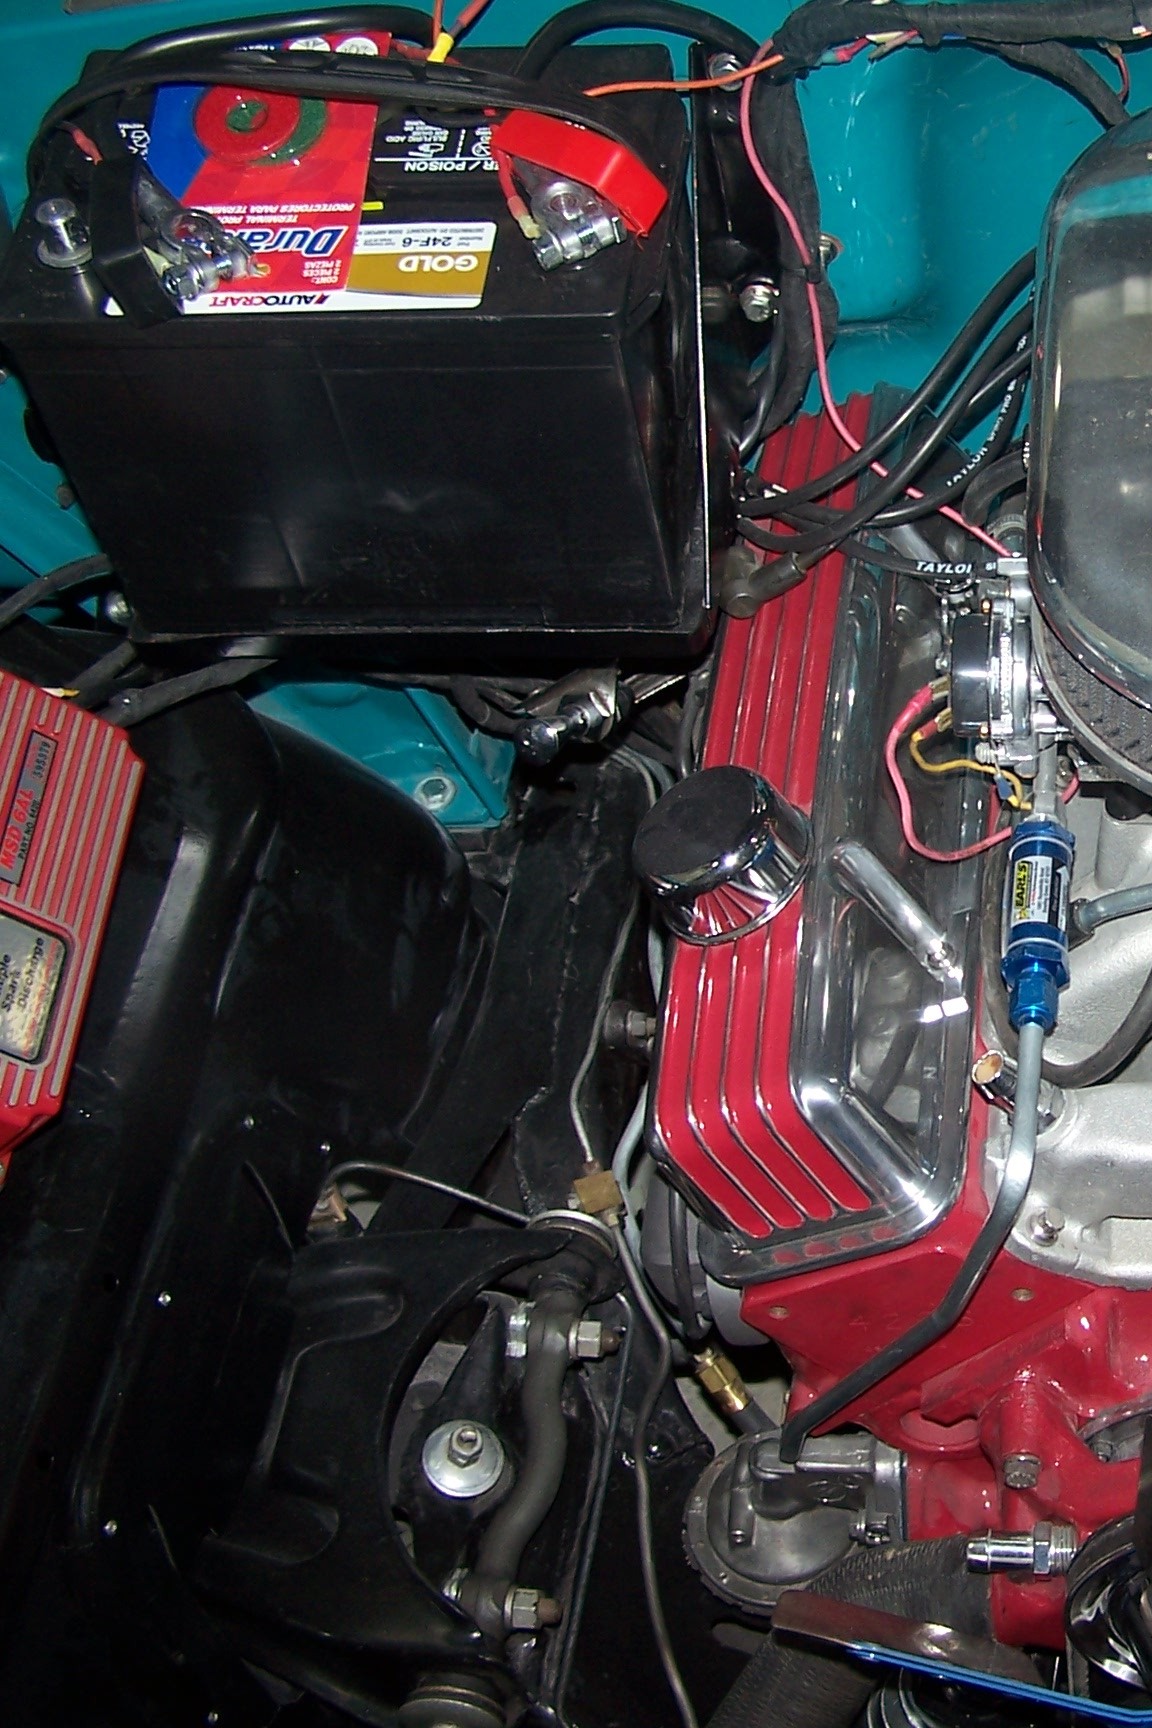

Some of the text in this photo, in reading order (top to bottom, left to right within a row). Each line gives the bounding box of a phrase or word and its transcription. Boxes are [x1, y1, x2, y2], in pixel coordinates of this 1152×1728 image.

[404, 161, 466, 171] POISON
[250, 204, 279, 213] PARA
[245, 214, 298, 224] TERMINAL
[402, 236, 453, 248] 24F-6
[398, 254, 478, 273] GOLD
[208, 293, 318, 307] AUTOCRAFT
[0, 825, 23, 870] MSD
[12, 788, 35, 824] 6AL
[1015, 864, 1027, 907] EARL'S
[17, 937, 45, 1010] Discharge
